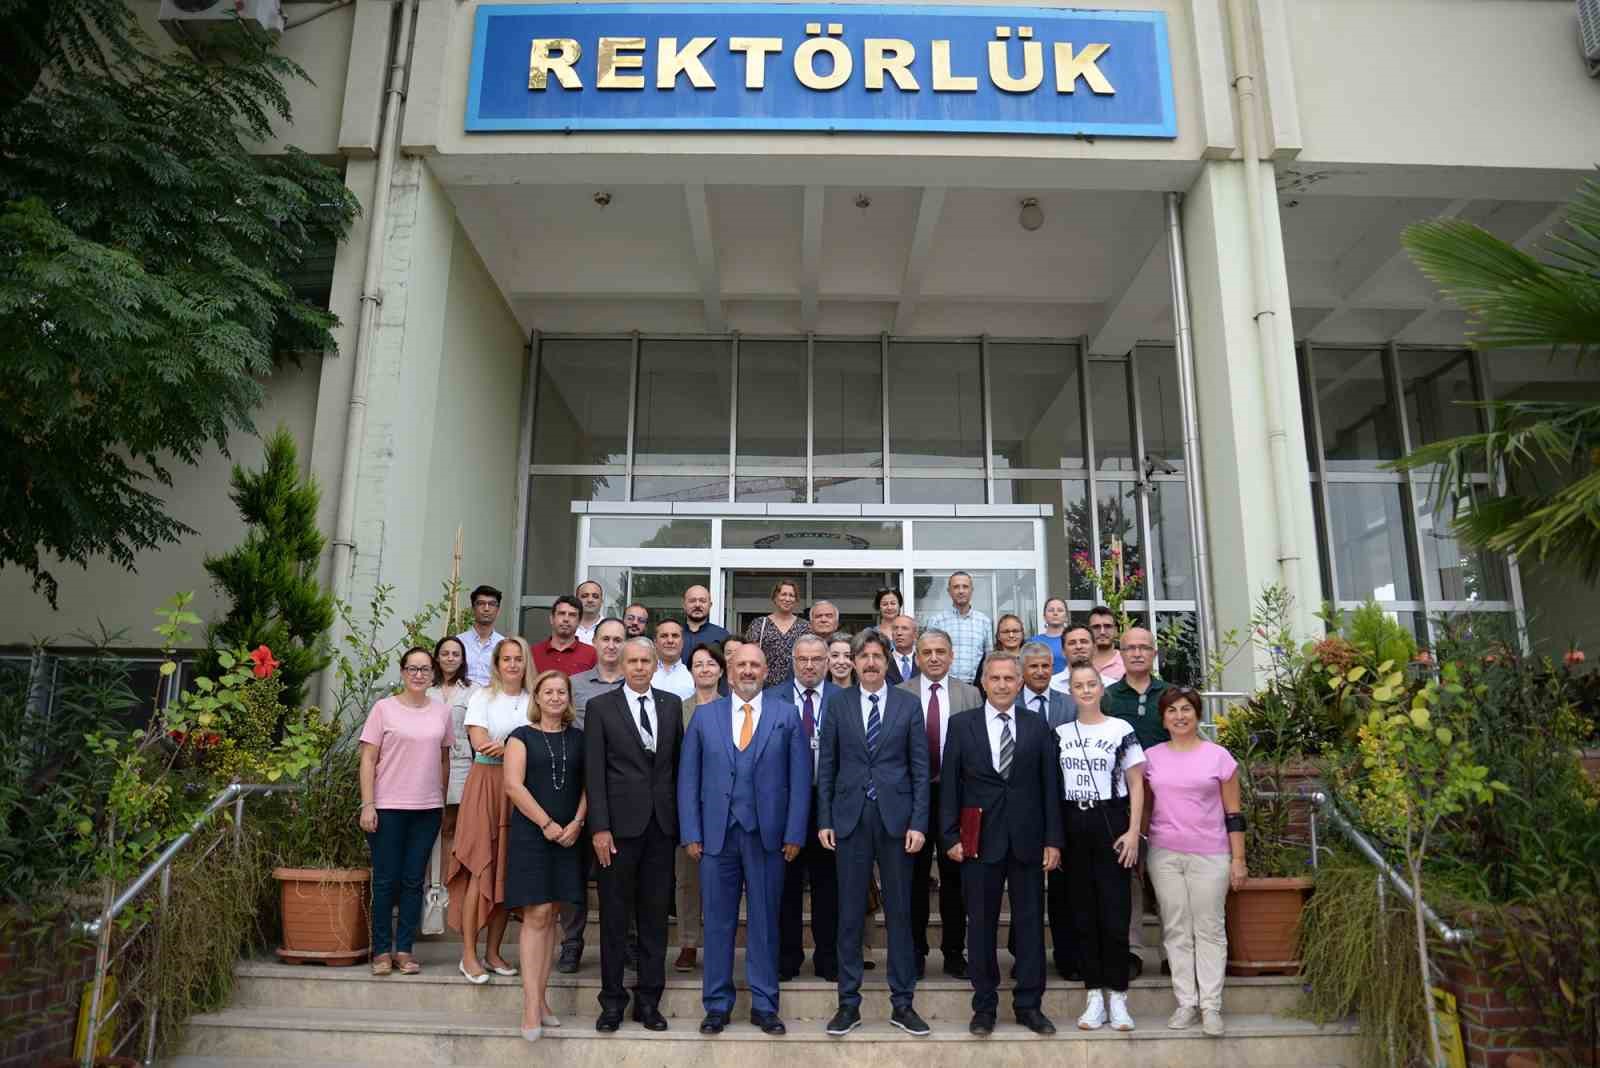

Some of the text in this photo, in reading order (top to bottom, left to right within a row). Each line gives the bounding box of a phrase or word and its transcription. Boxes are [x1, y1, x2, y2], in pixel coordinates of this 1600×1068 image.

[528, 23, 1116, 94] REKTÖRLÜK
[1063, 738, 1091, 750] OVE
[1060, 757, 1107, 771] FOREVER
[1077, 774, 1090, 786] OR
